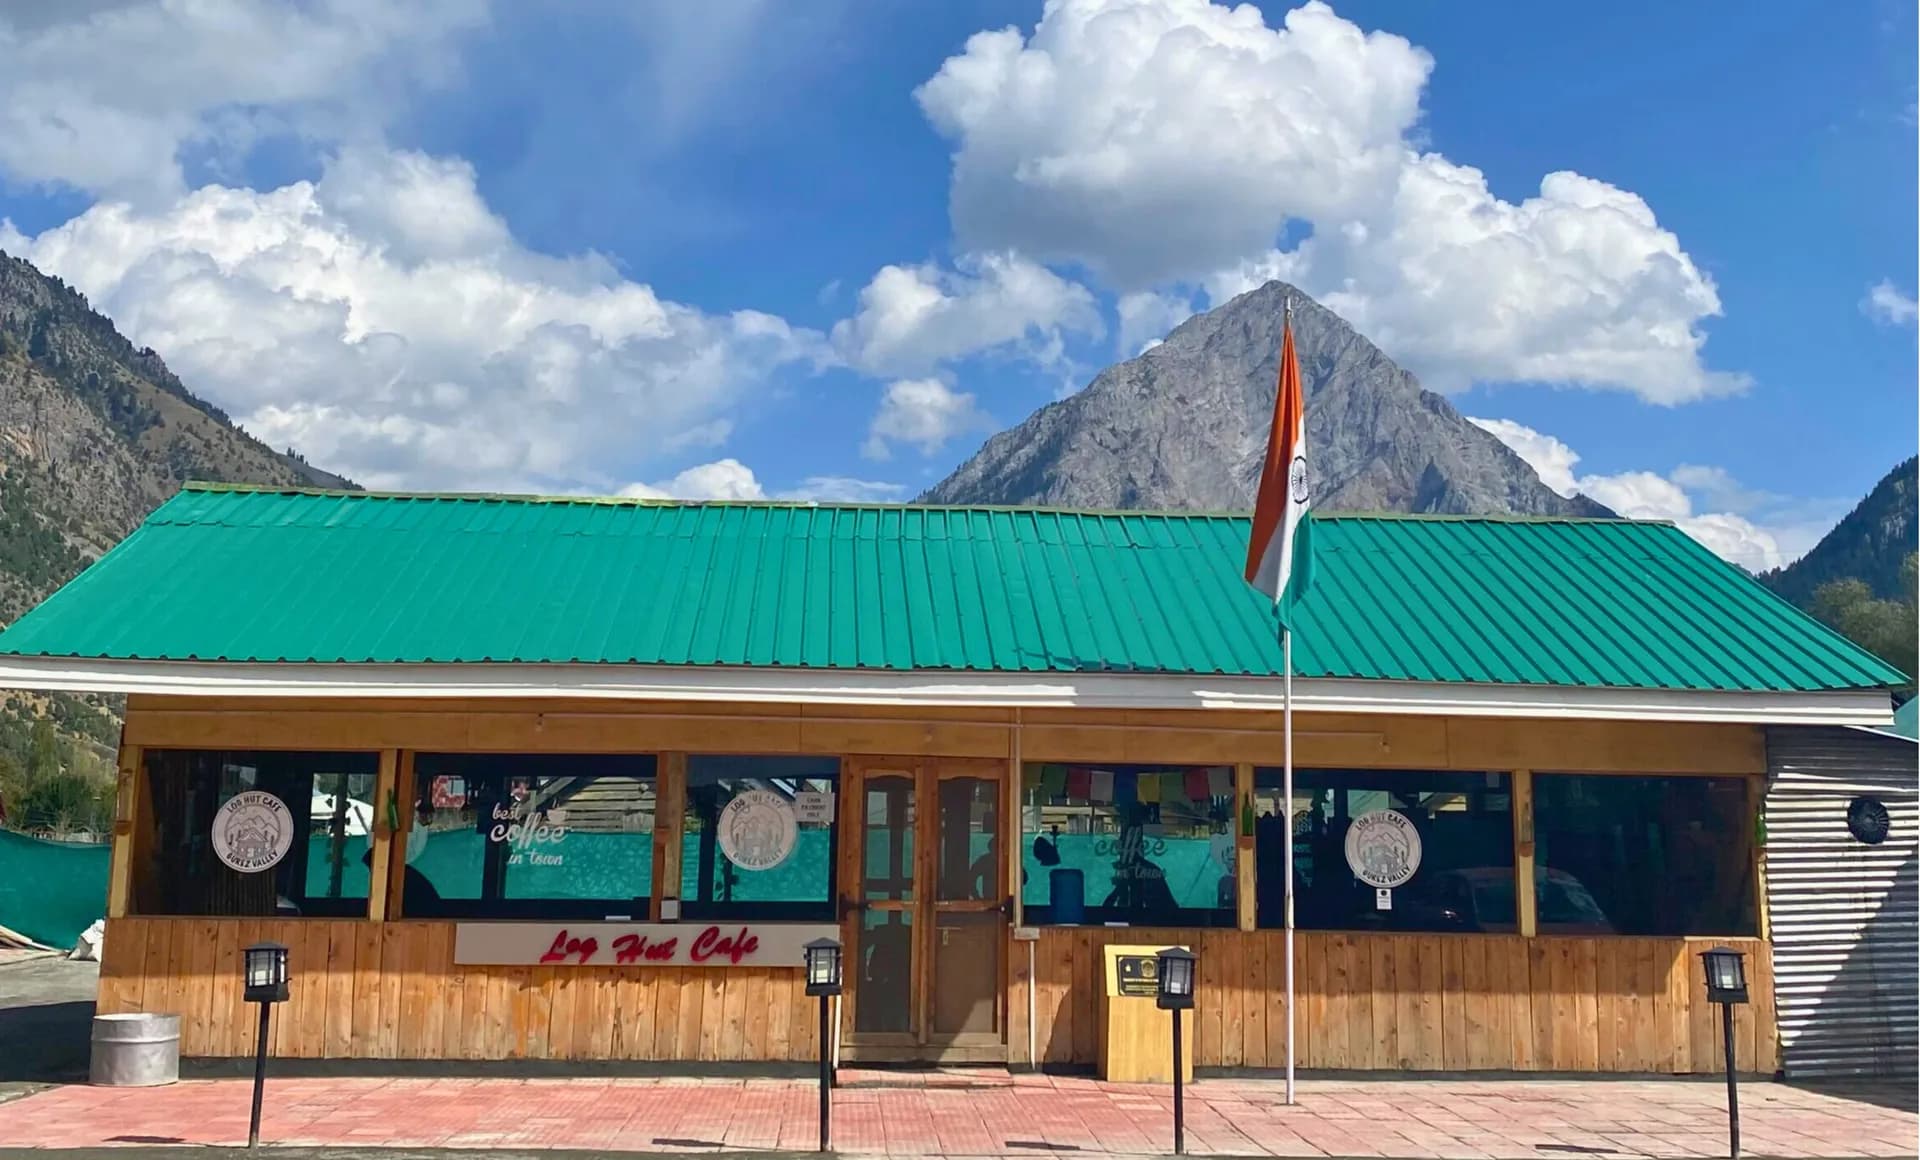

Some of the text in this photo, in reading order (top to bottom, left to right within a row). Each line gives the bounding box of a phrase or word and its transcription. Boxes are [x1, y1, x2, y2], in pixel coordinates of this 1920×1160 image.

[244, 795, 261, 804] HUT
[262, 797, 282, 813] CAFE
[492, 801, 521, 820] best
[490, 812, 568, 849] coffee
[1387, 813, 1407, 829] CAFE
[1094, 826, 1168, 864] coffee
[252, 849, 278, 868] VALLEY
[506, 848, 563, 865] in town
[1388, 864, 1411, 884] VALLEY
[540, 926, 759, 964] Log Hut Cafe
